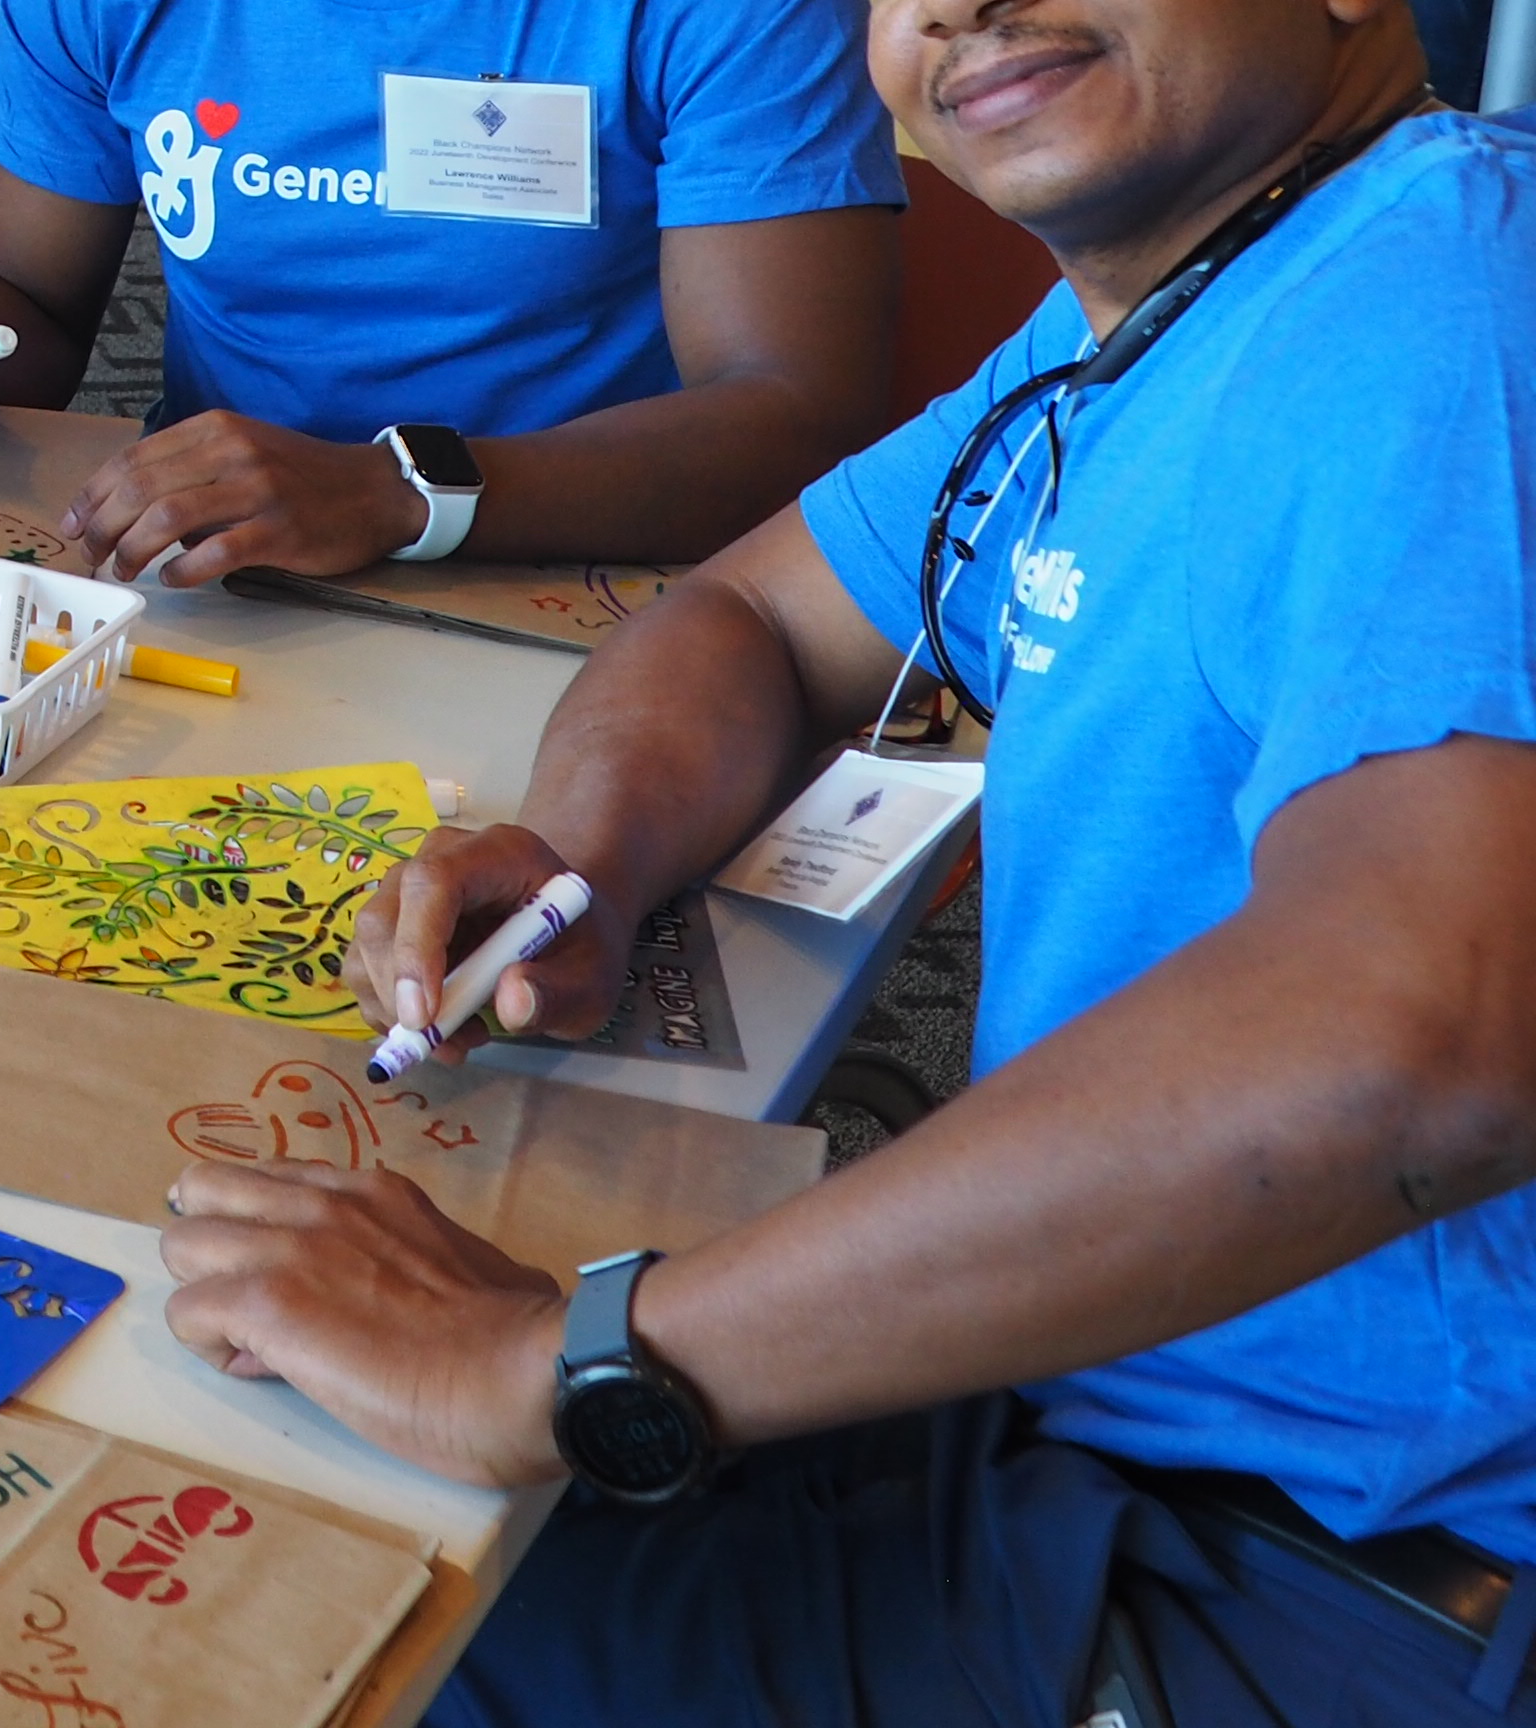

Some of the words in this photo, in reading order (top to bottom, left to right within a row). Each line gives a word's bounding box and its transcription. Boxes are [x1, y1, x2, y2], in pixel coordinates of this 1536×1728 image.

[433, 139, 457, 148] Black
[461, 141, 511, 153] Champions
[514, 145, 552, 155] Network
[232, 153, 388, 206] Gener
[445, 169, 494, 180] Lawrence
[497, 173, 541, 184] Williams
[429, 179, 464, 188] Business
[466, 181, 518, 192] Management
[634, 906, 684, 952] hop
